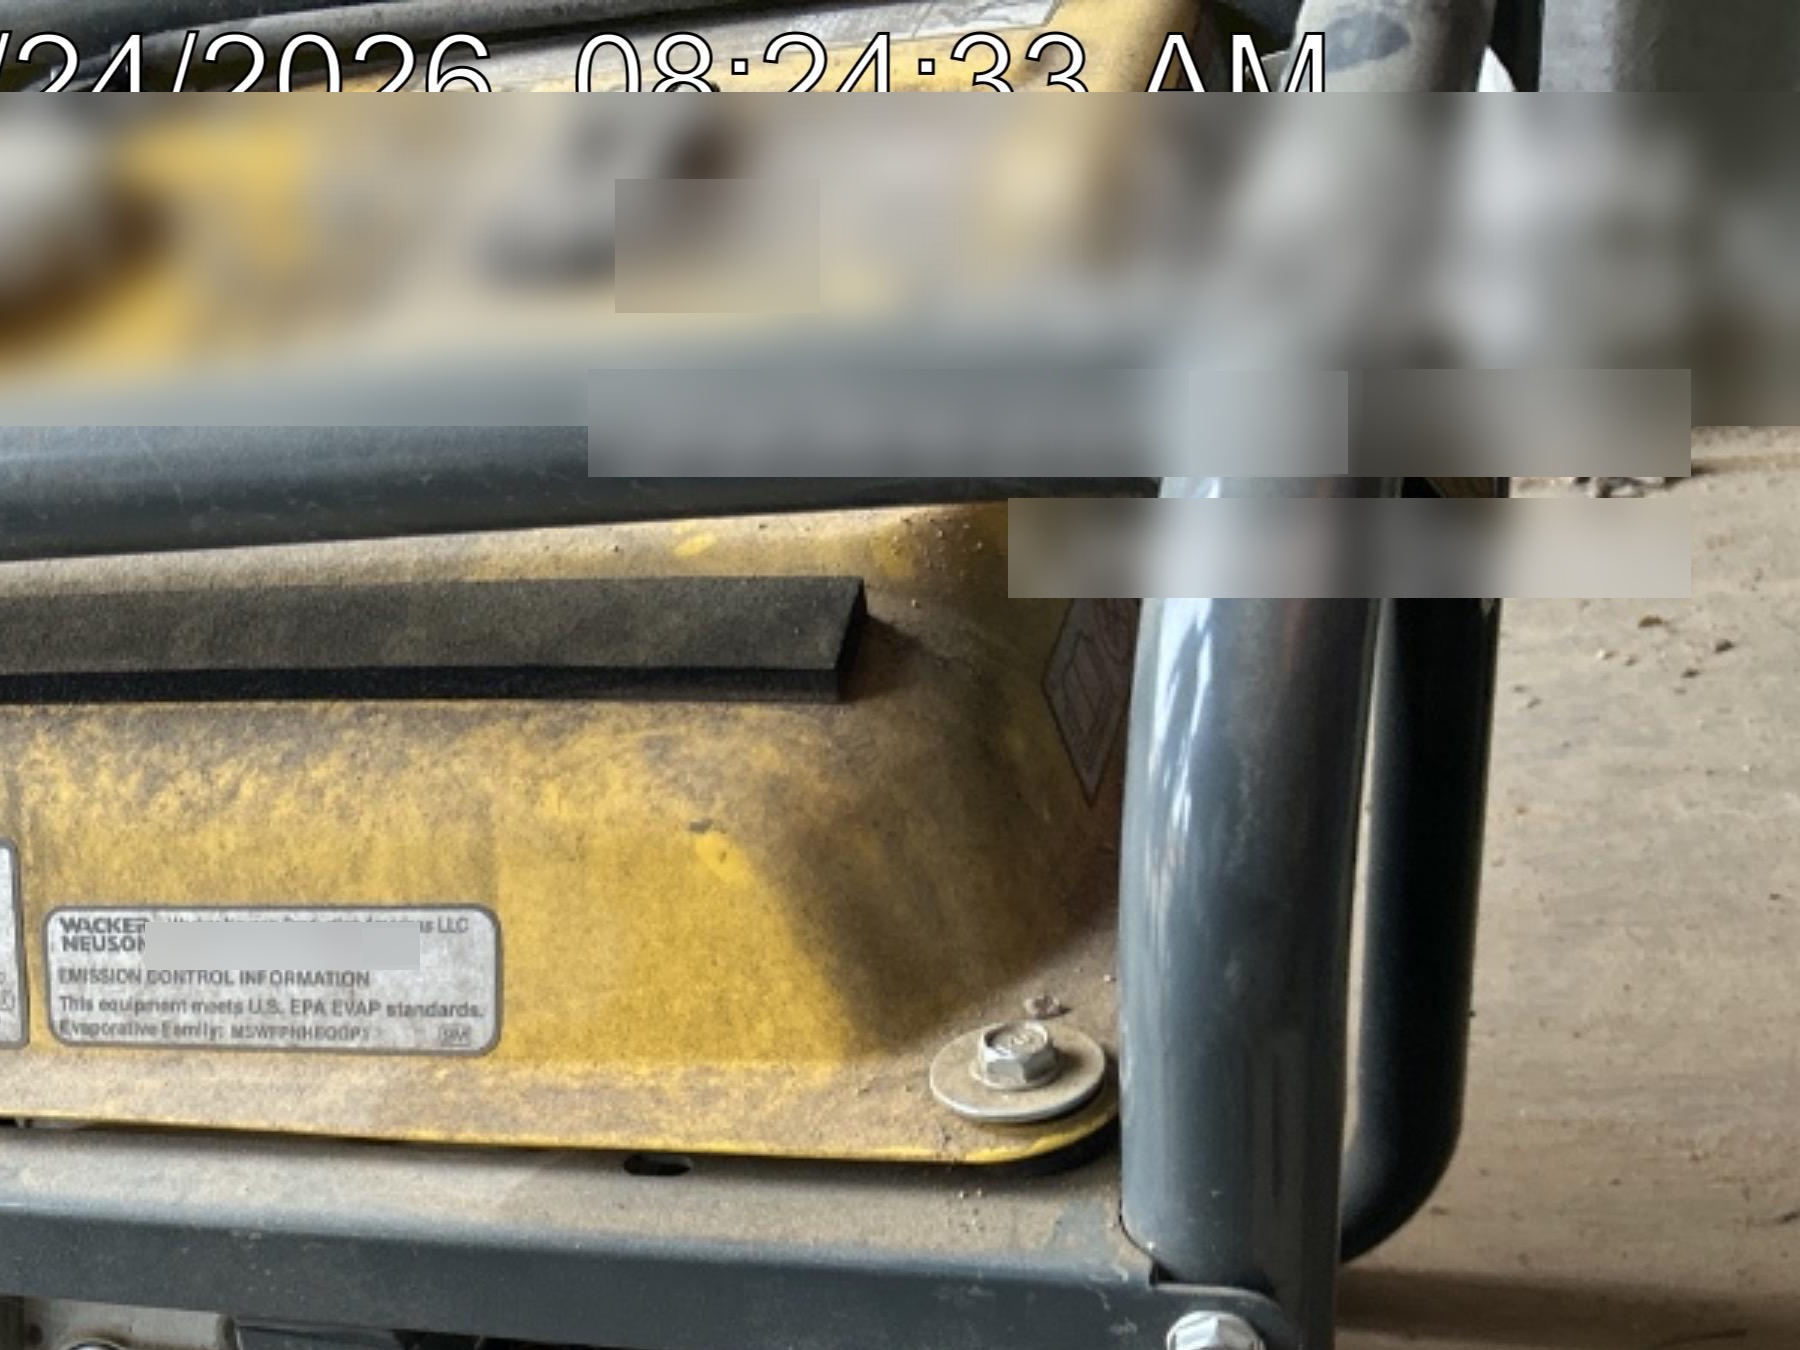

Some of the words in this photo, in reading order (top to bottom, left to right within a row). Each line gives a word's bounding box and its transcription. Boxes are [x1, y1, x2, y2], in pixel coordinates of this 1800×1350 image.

[437, 917, 469, 933] LLC
[58, 968, 141, 984] EMISSION
[147, 970, 233, 985] CONTROL
[239, 970, 370, 987] INFORMATION
[59, 996, 94, 1012] This
[99, 998, 187, 1019] equipment
[191, 1002, 244, 1015] meets
[248, 998, 284, 1015] U.S.
[289, 1000, 327, 1016] EPA
[332, 1001, 381, 1017] EVAP
[386, 1002, 484, 1019] standards.
[60, 1020, 156, 1040] Evaporative
[161, 1022, 223, 1041] Family:
